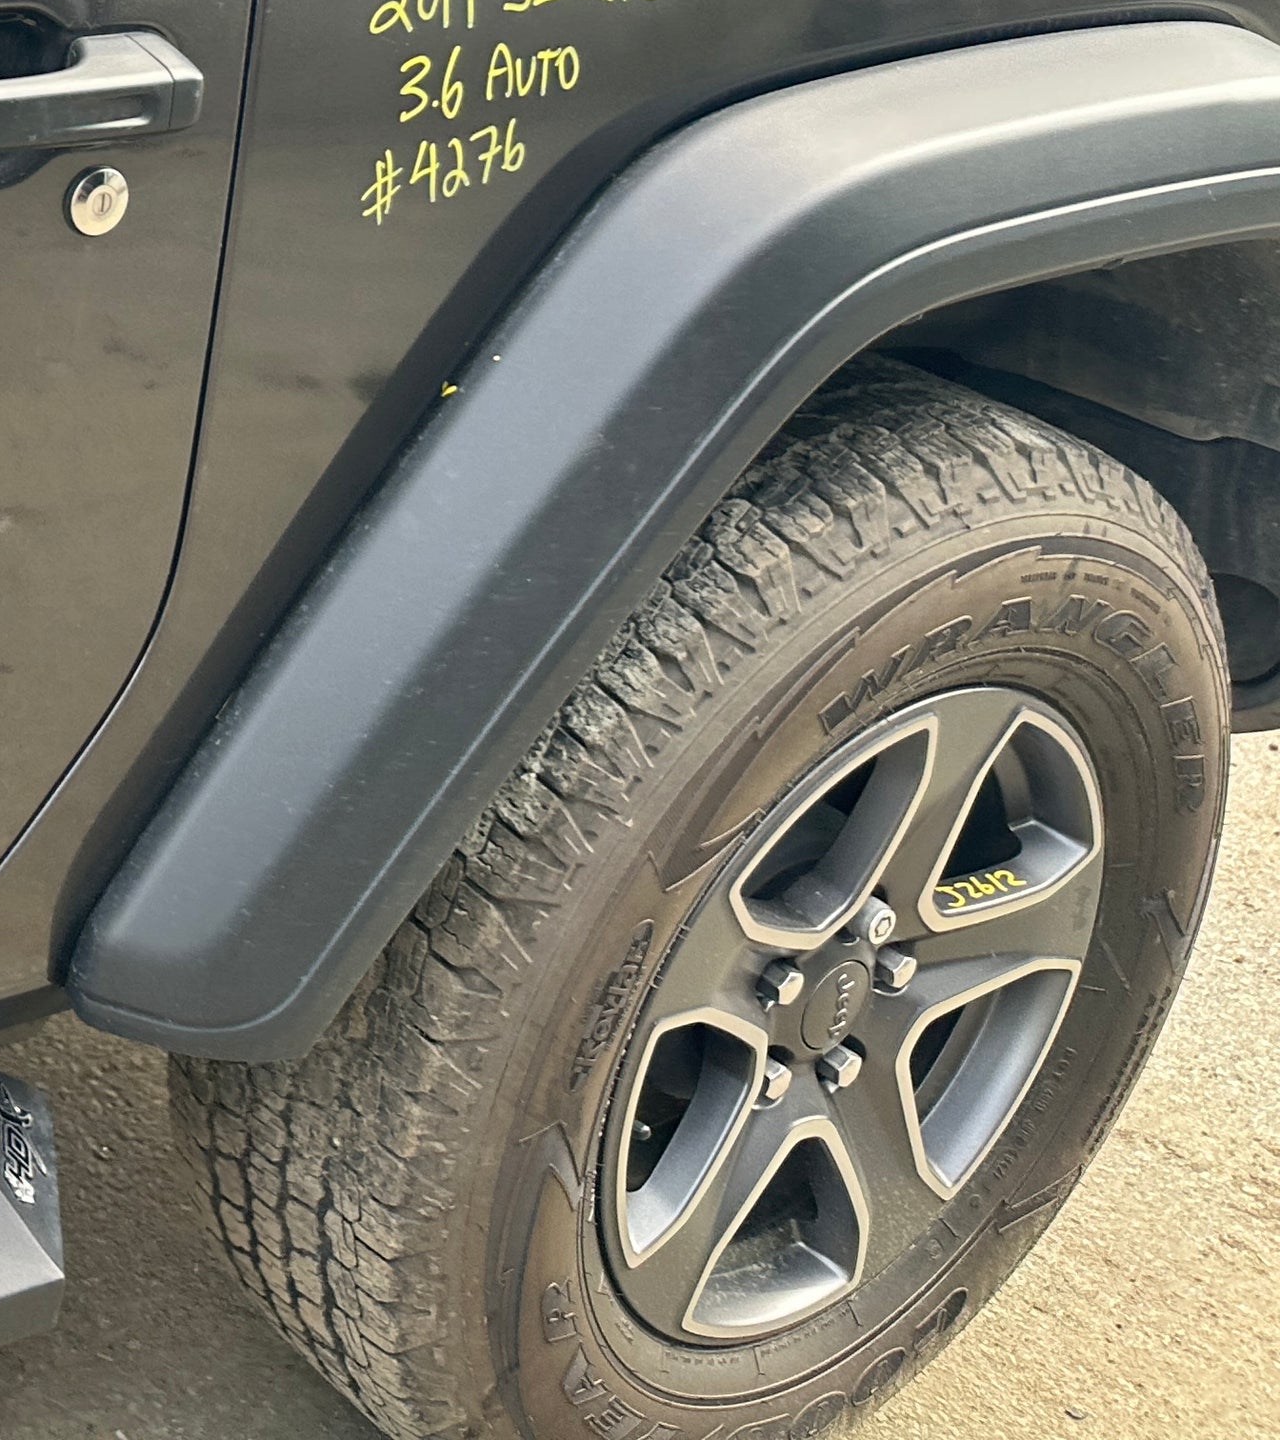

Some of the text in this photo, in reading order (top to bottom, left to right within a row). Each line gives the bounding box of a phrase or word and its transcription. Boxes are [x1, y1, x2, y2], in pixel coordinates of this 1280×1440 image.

[400, 43, 580, 123] 3.6 AUTO
[361, 118, 525, 226] #4276
[817, 593, 1207, 816] WRANGLER
[934, 869, 1027, 908] J2612
[541, 1279, 969, 1440] GOOEAR
